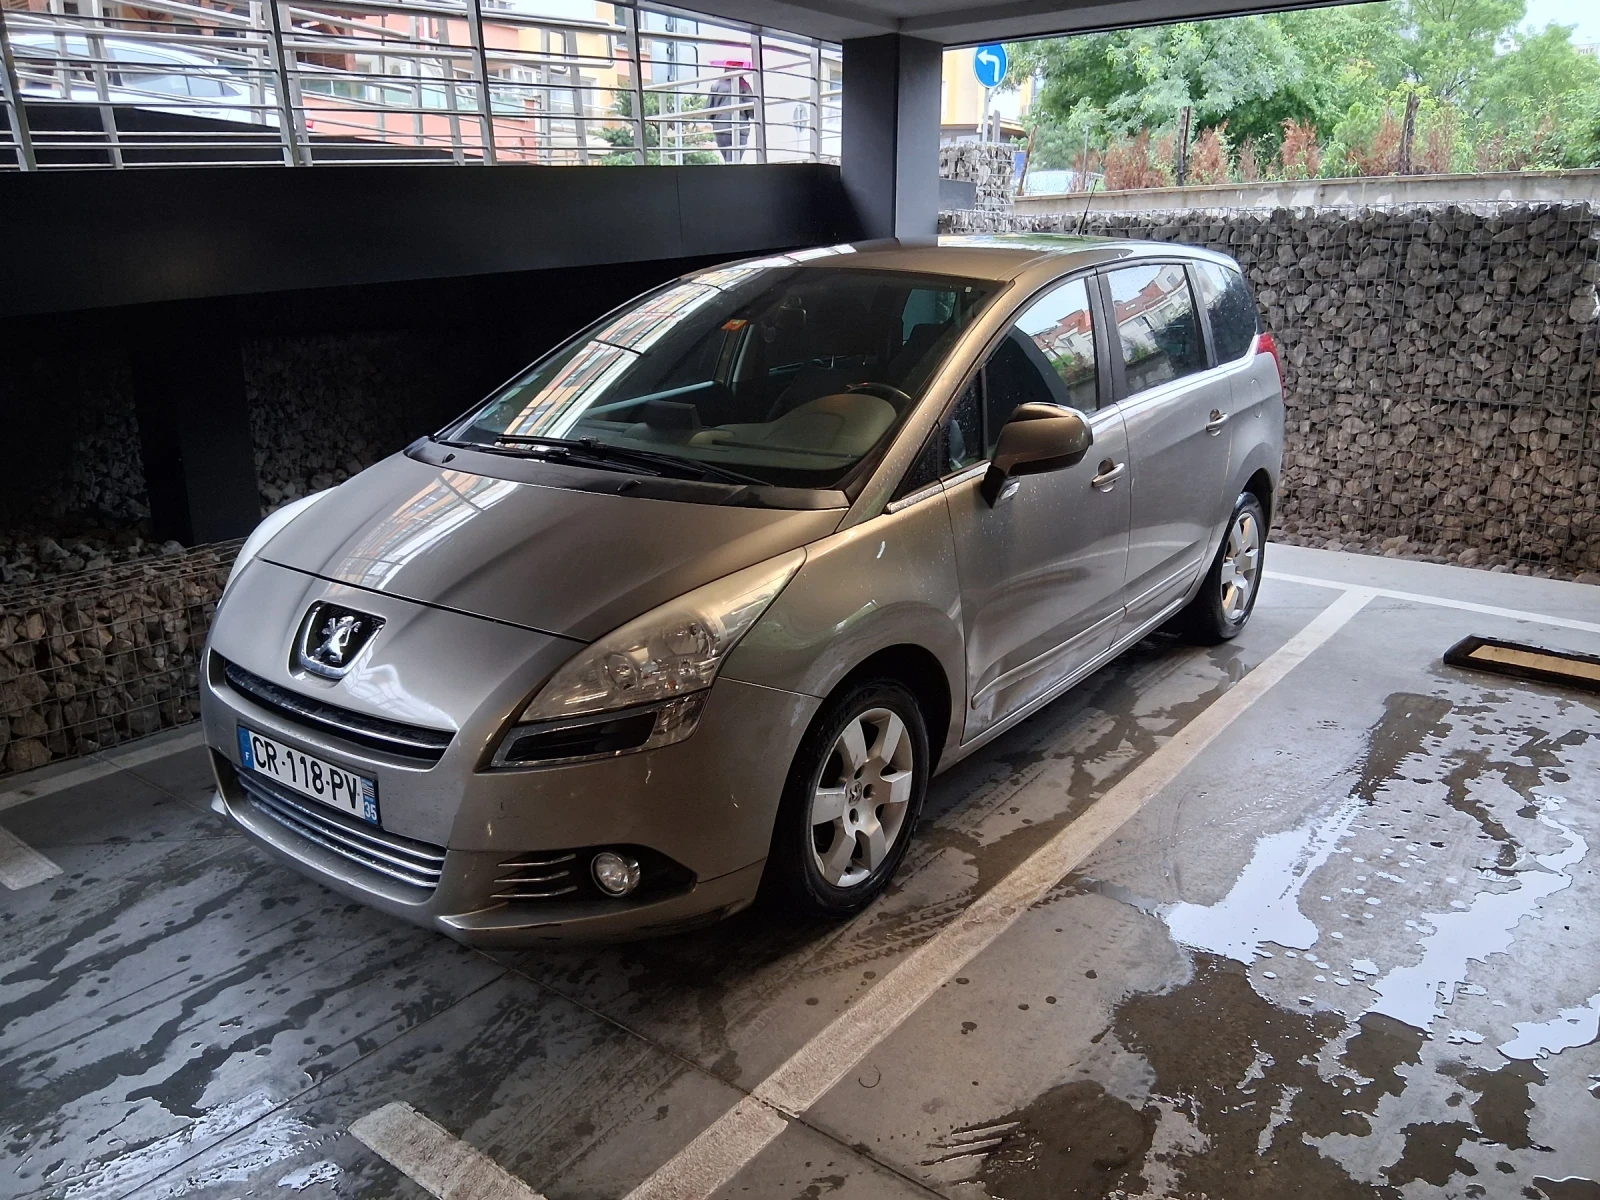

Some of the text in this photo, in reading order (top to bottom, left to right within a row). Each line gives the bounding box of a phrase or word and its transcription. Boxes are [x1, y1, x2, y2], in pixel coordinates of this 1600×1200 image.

[245, 752, 250, 761] F
[252, 736, 357, 809] CR-118-PV
[364, 801, 378, 821] 35
